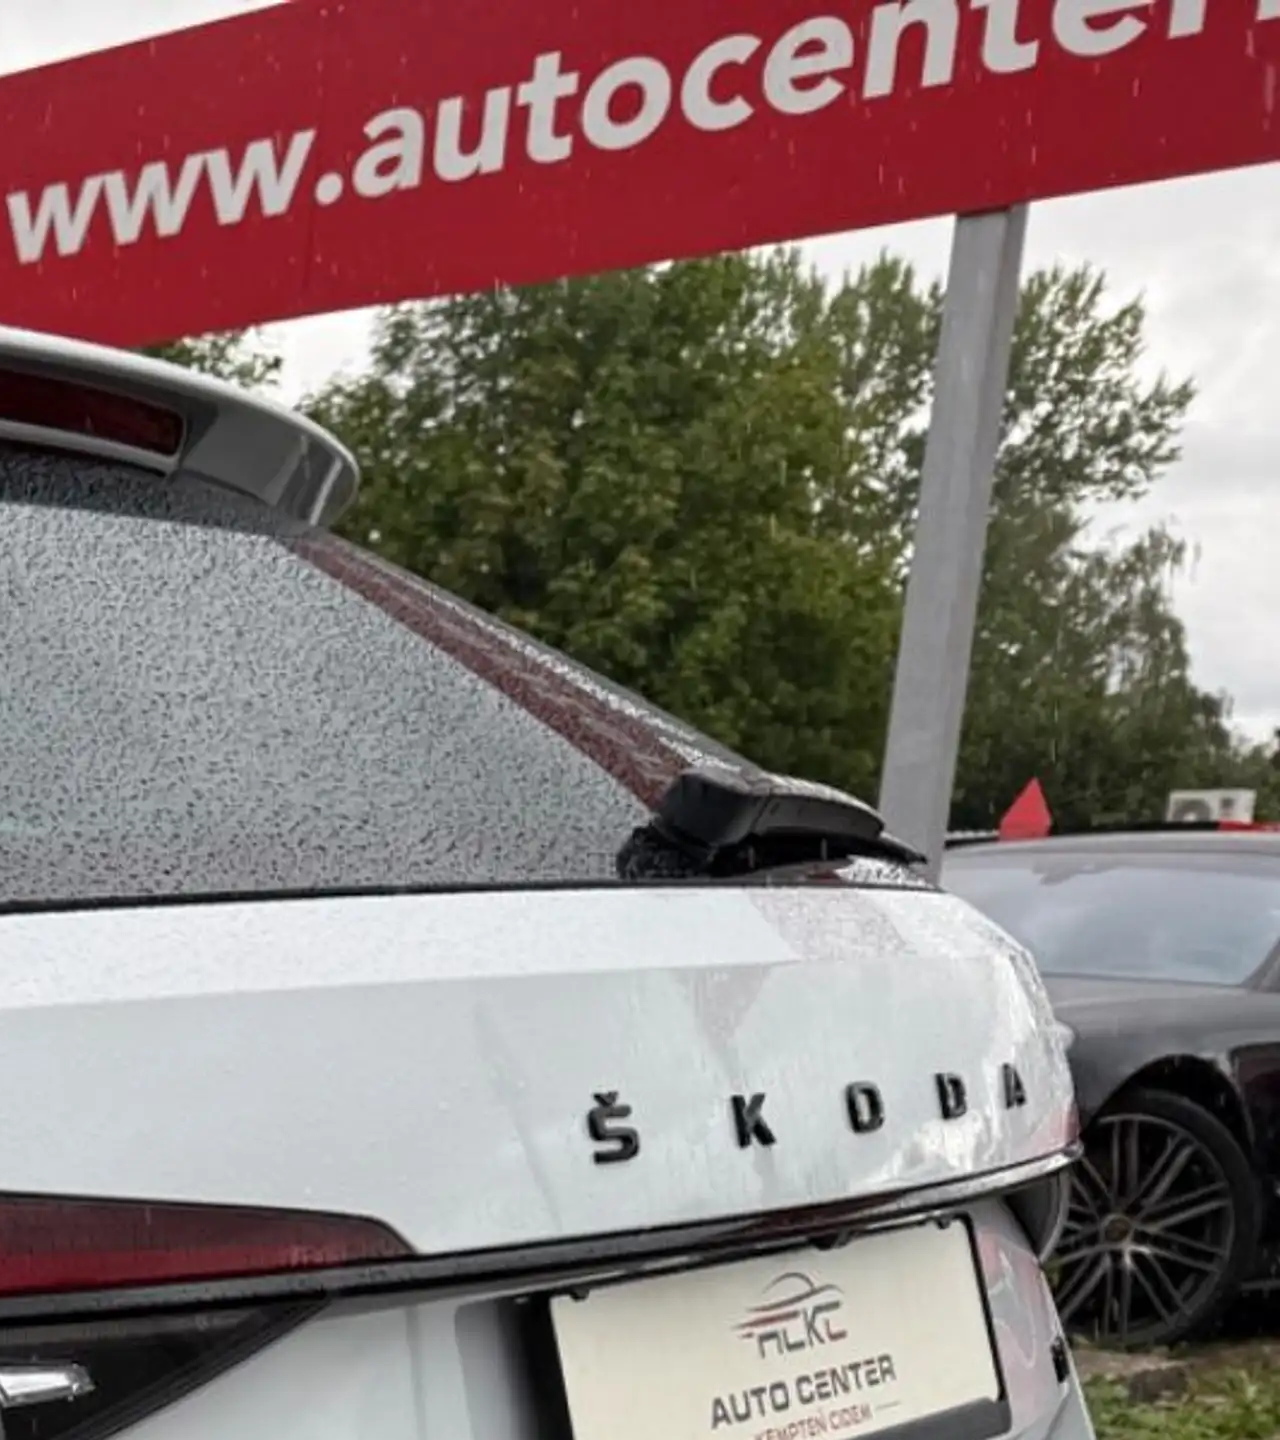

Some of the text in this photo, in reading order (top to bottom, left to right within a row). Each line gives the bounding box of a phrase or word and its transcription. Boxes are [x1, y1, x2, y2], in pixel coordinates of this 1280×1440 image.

[6, 0, 1280, 263] www.autocente
[587, 1062, 1028, 1164] ŠKODA
[711, 1353, 897, 1430] AUTO CENTER
